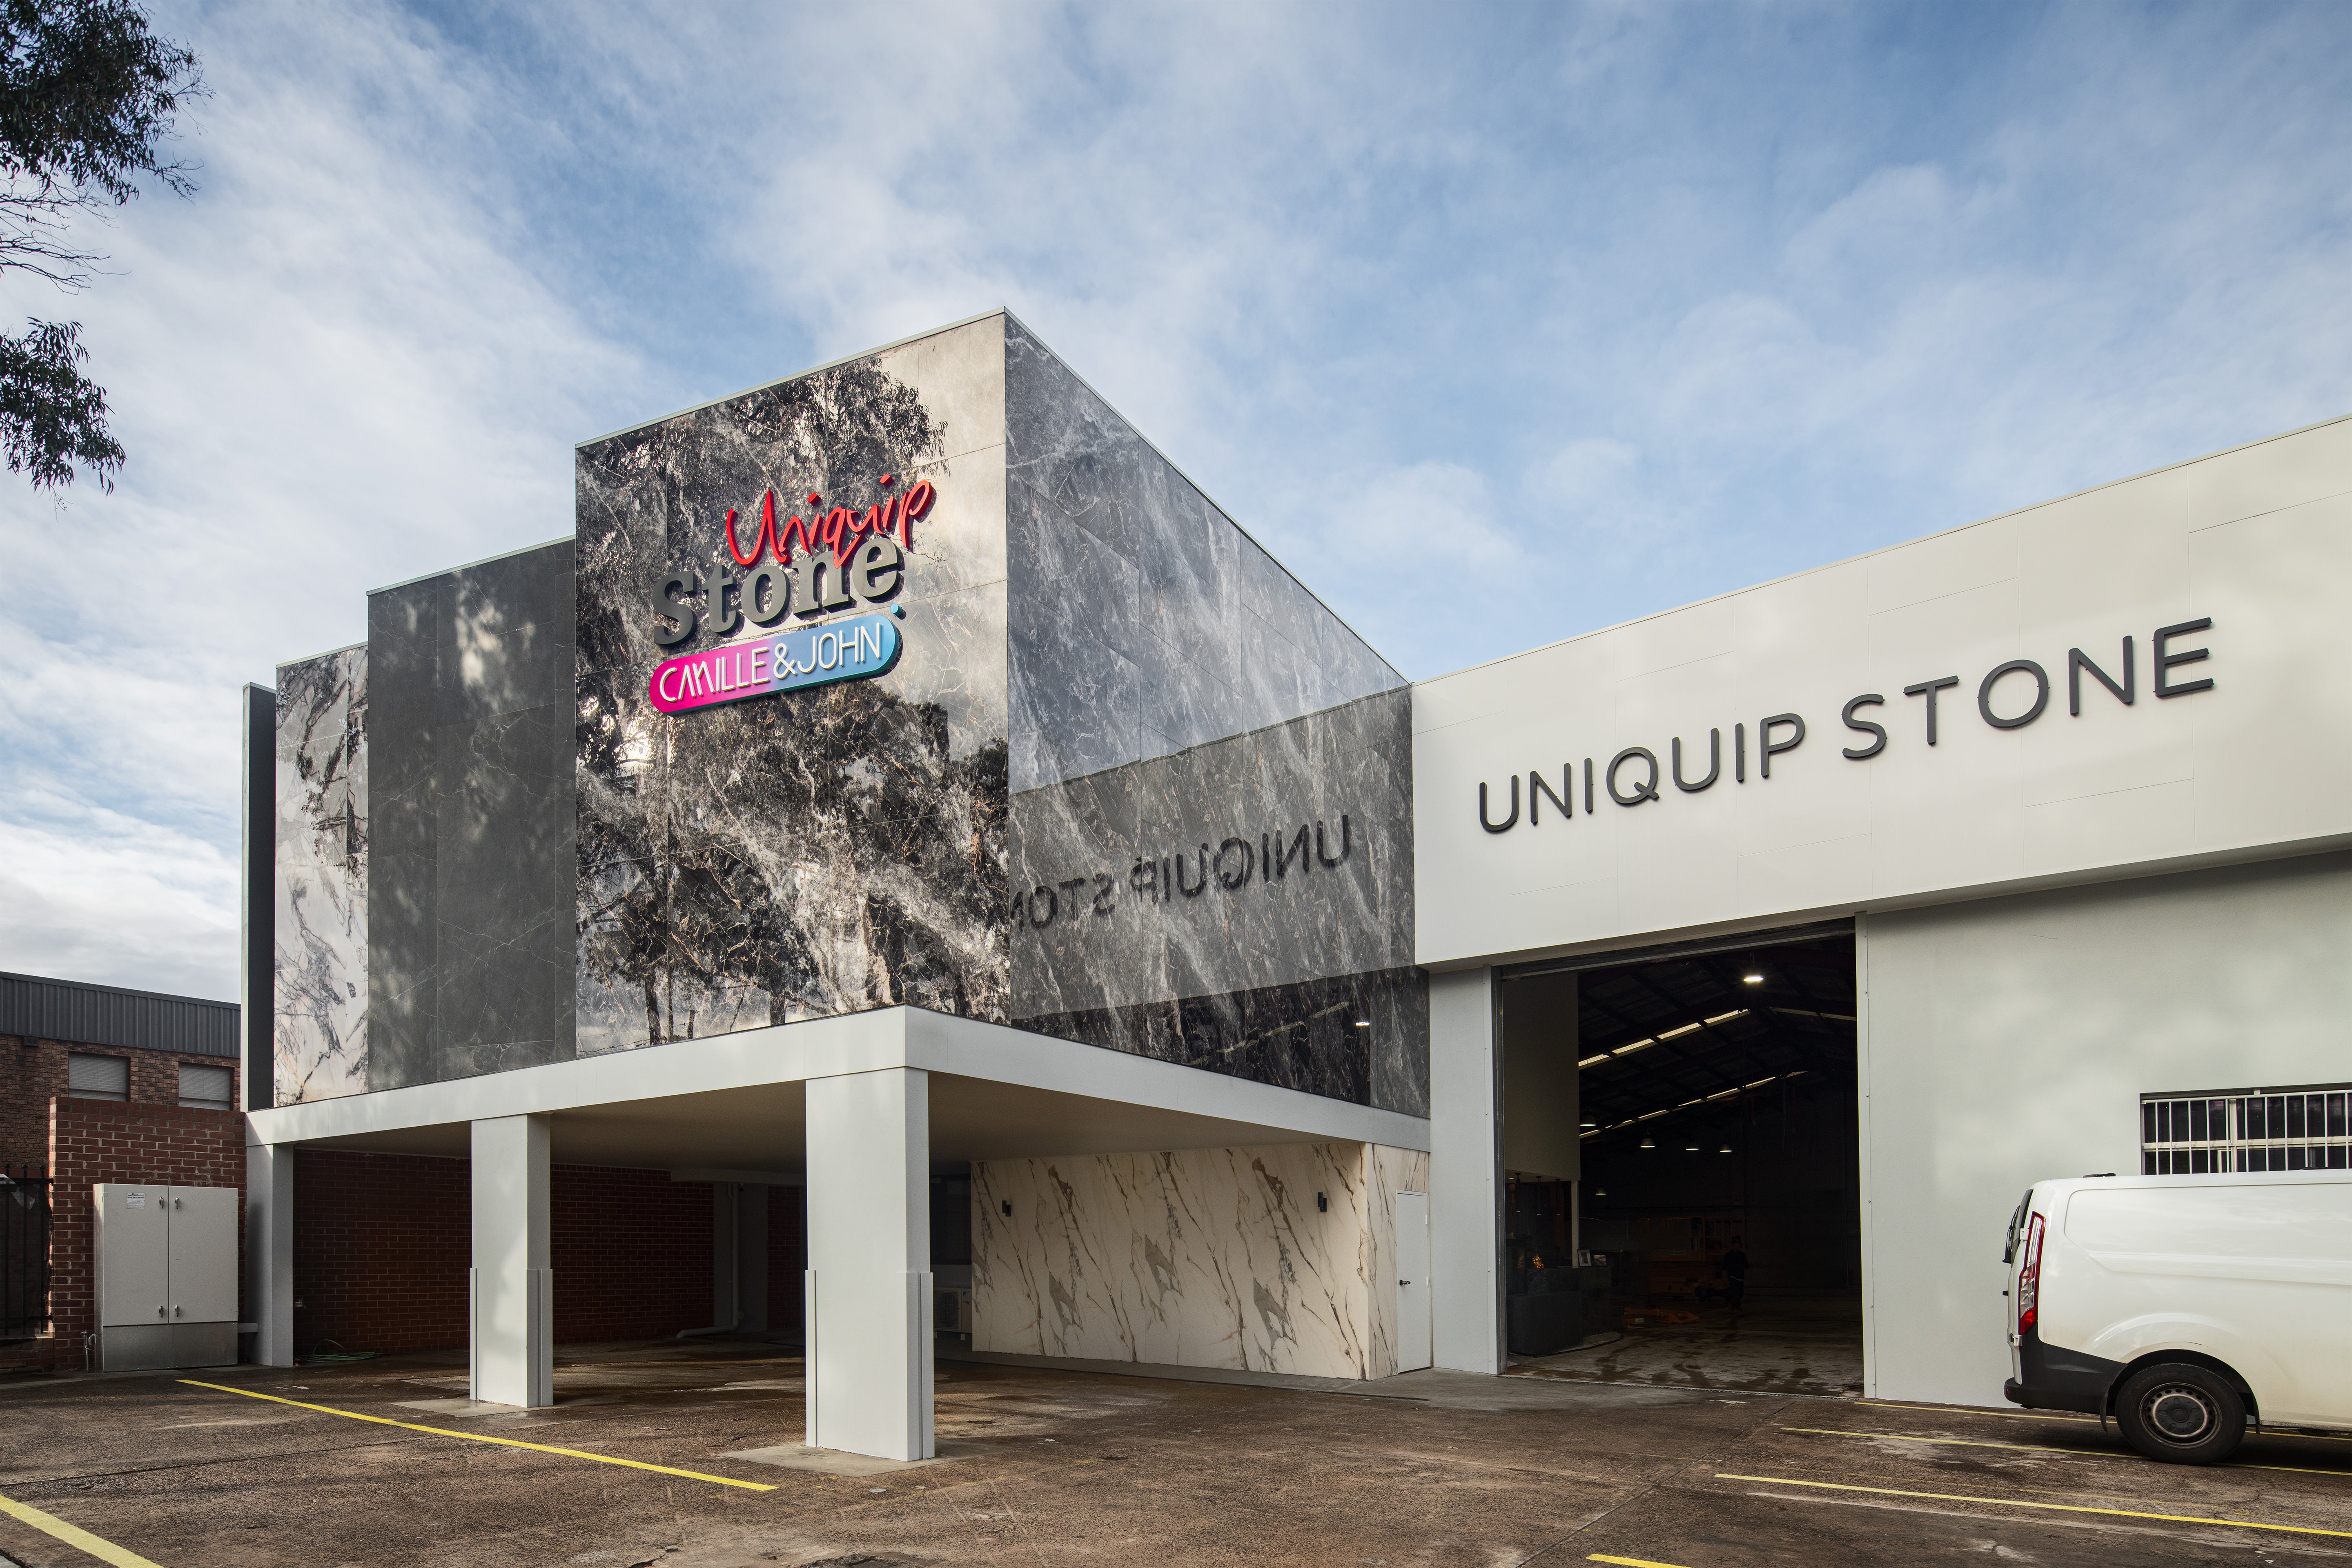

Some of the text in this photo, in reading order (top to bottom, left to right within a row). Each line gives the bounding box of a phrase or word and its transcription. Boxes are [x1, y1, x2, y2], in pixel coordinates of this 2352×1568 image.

[726, 474, 935, 568] Uniquip
[654, 537, 904, 645] stone
[1479, 616, 2215, 834] UNIQUIP STONE
